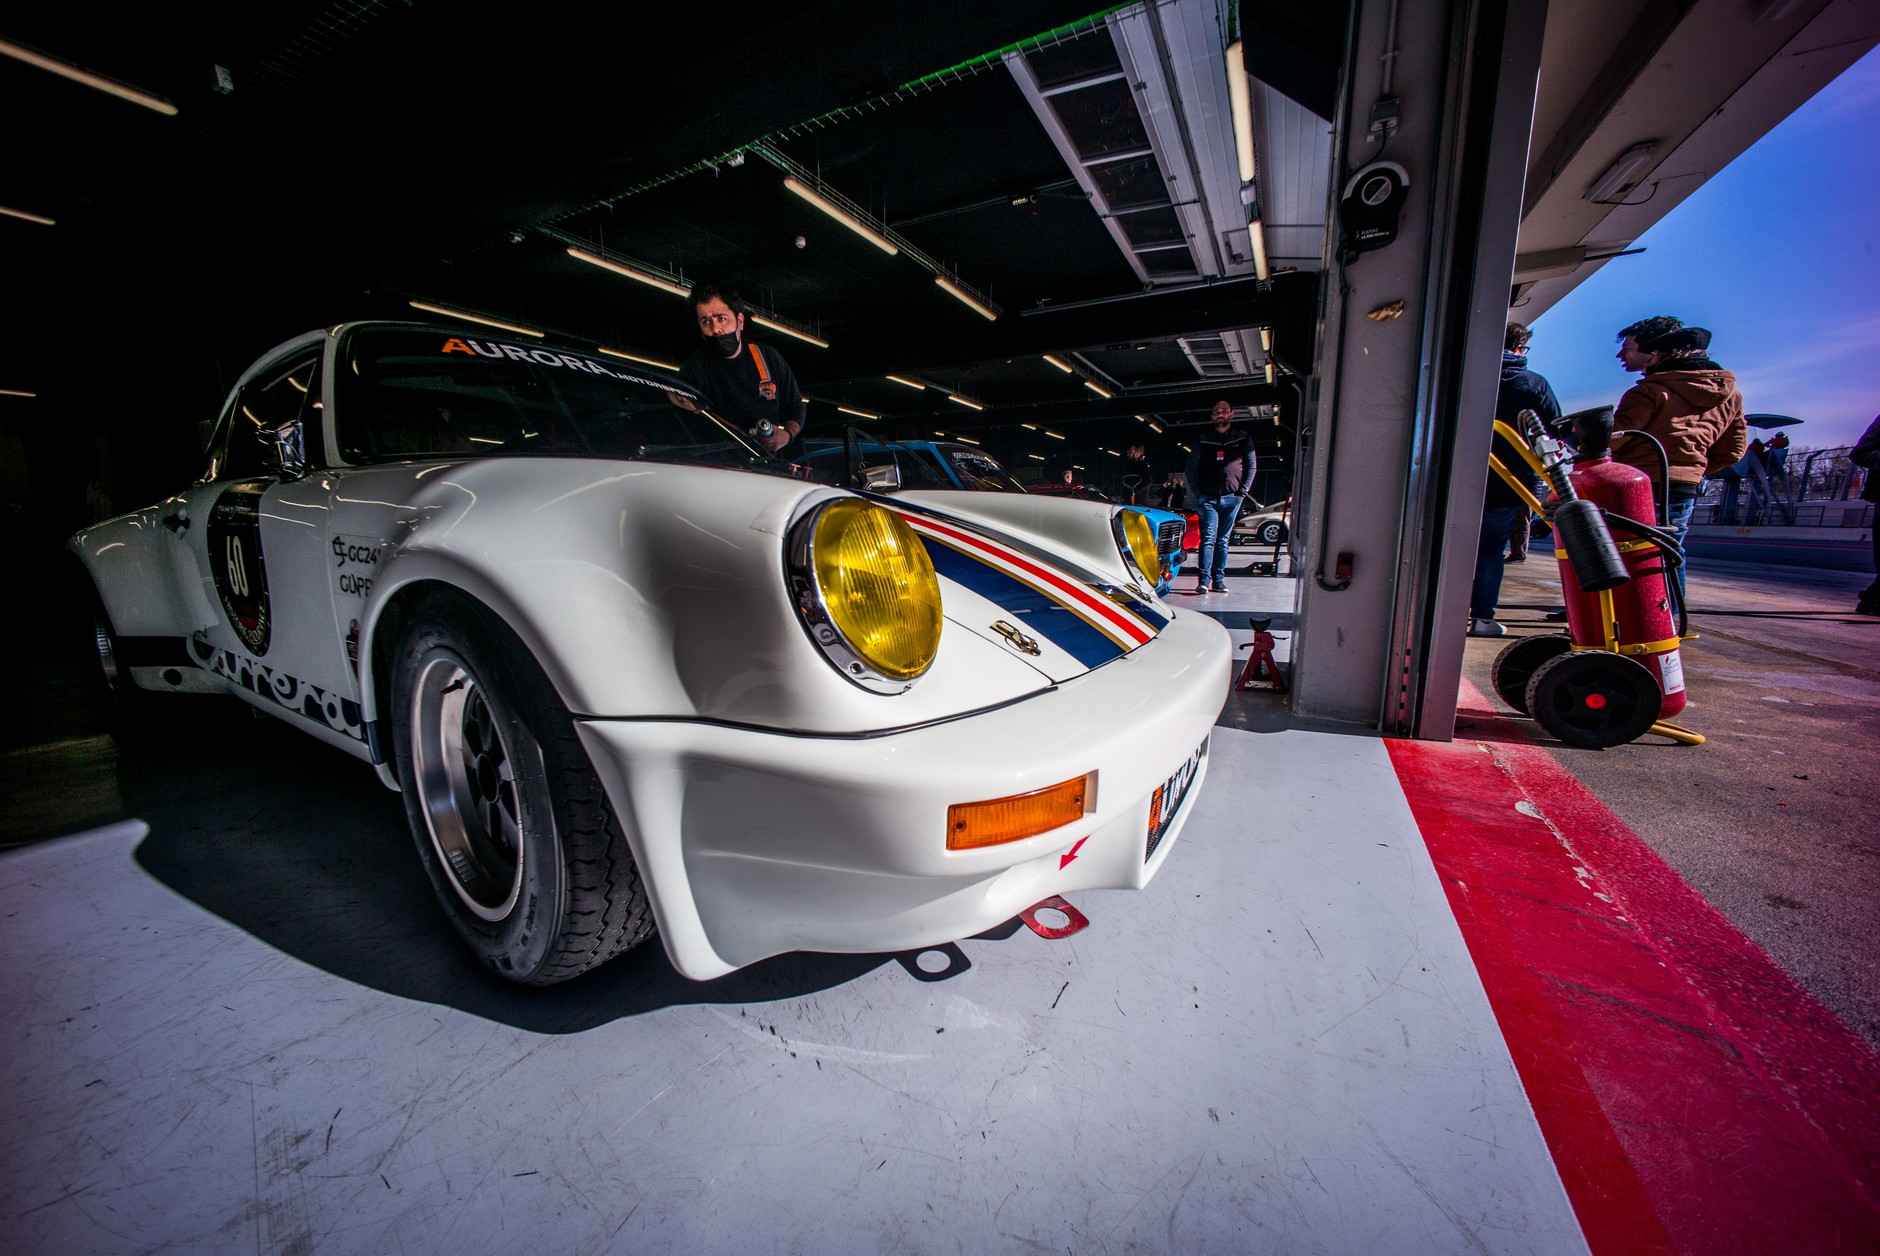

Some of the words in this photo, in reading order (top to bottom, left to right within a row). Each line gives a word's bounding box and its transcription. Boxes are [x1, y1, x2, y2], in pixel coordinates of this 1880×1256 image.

[441, 337, 619, 379] AURORA
[615, 373, 698, 401] MOTORSPORT
[226, 534, 249, 597] 60
[186, 624, 362, 739] Carrera
